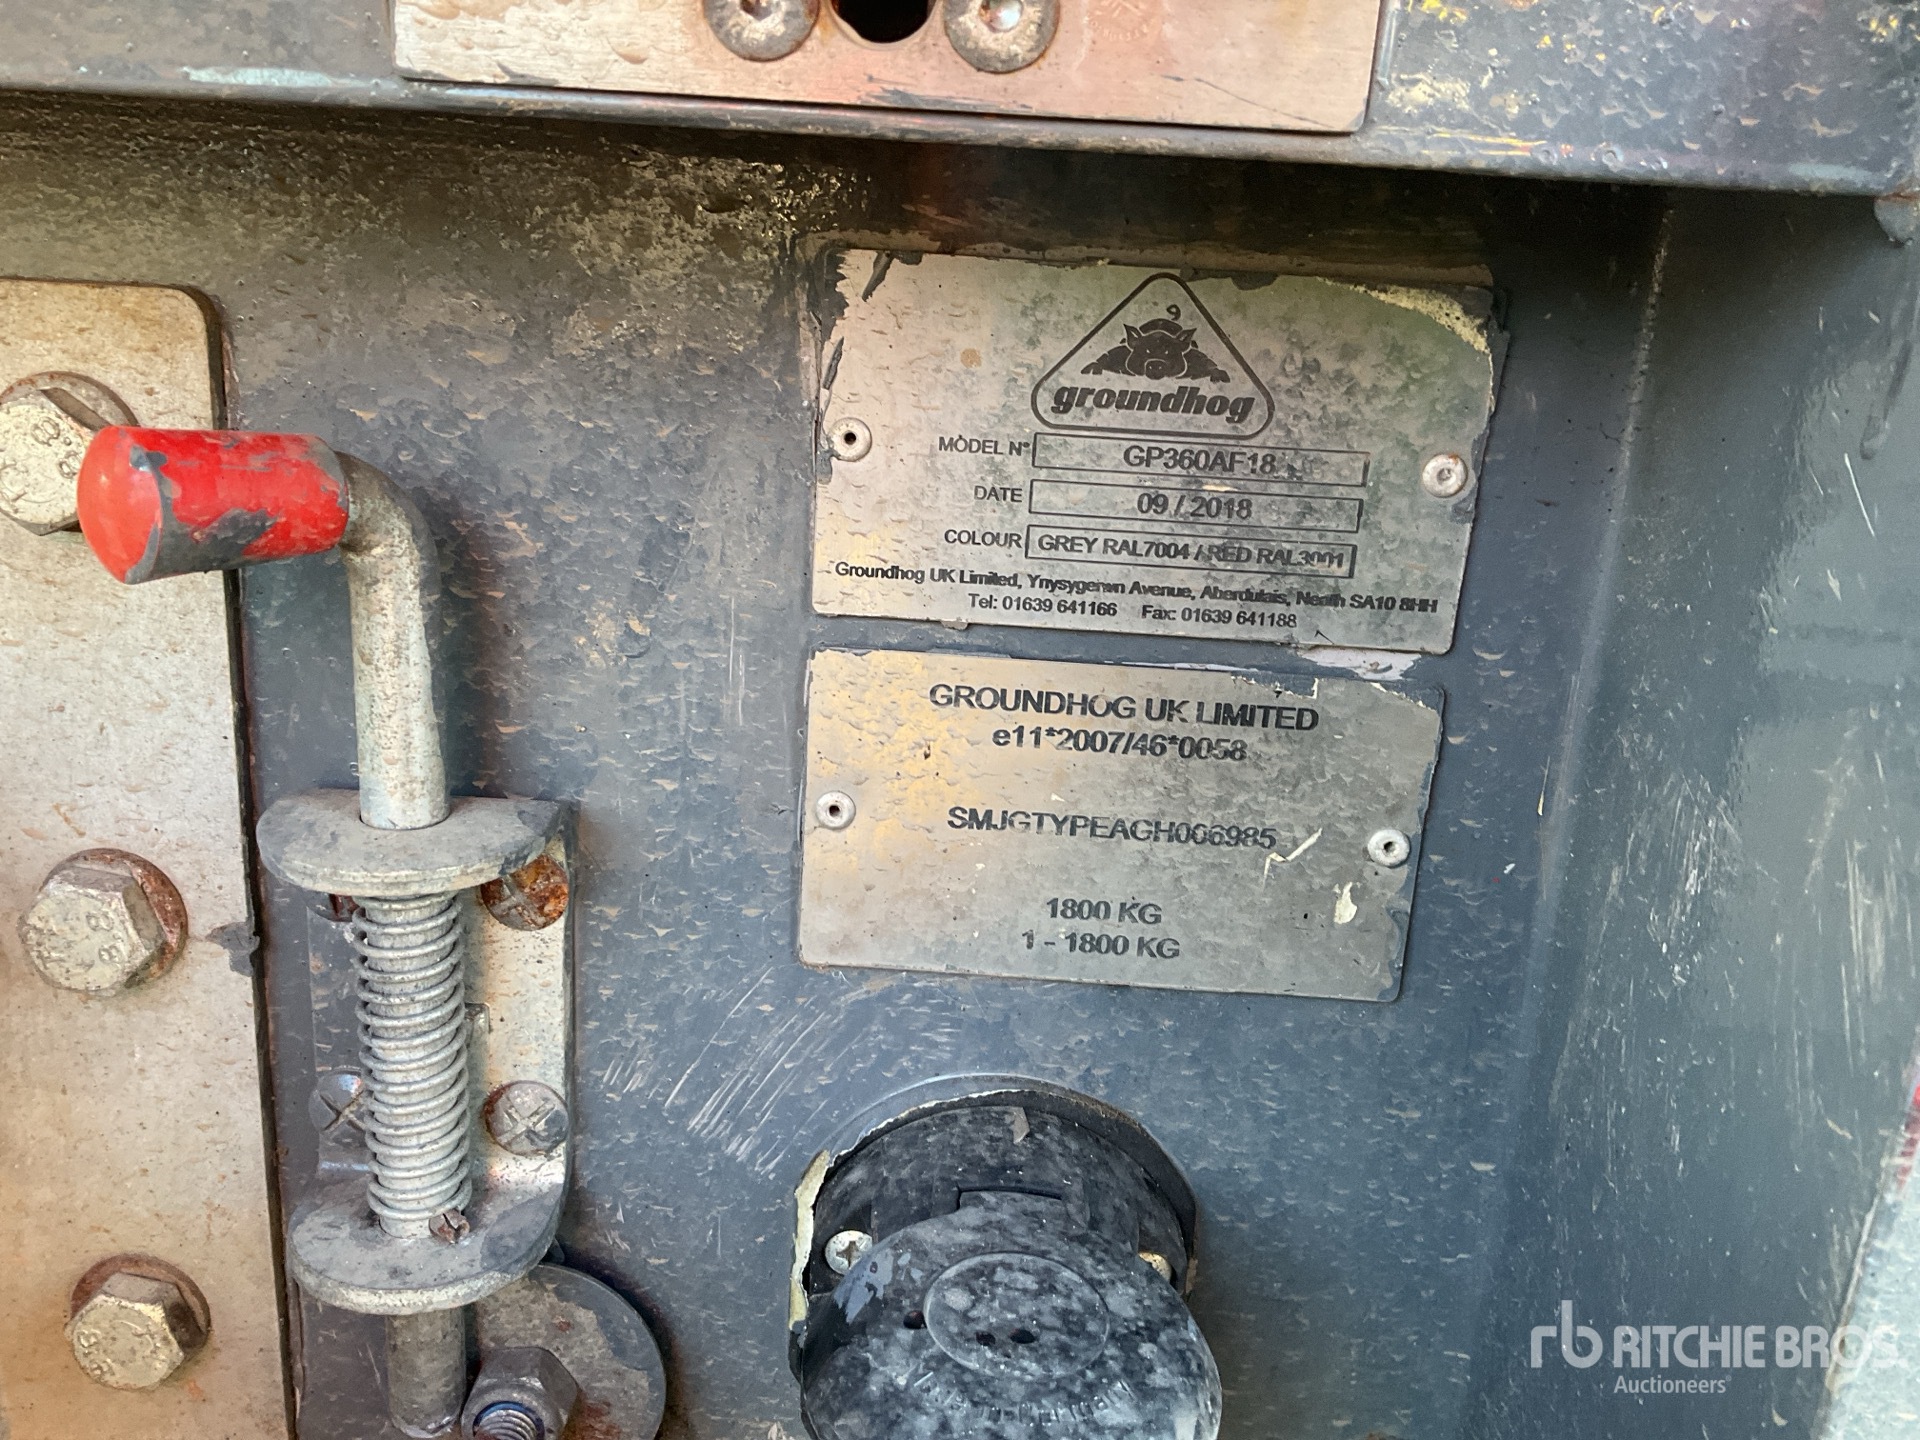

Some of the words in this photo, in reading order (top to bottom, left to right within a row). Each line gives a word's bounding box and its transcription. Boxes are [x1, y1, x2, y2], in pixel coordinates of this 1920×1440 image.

[1050, 385, 1256, 424] groundhog
[938, 436, 1004, 456] MODEL
[1123, 445, 1277, 475] GP360AF18
[974, 485, 1023, 503] DATE
[1137, 492, 1169, 515] 09
[1190, 496, 1253, 520] 2018
[944, 529, 1023, 549] COLOUR
[1037, 534, 1099, 554] GREY
[1102, 538, 1190, 560] RAL7004
[1207, 544, 1250, 563] RED
[835, 561, 925, 585] Groundhog
[929, 567, 955, 584] UK
[958, 569, 1023, 590] Limited,
[1128, 581, 1196, 601] Avenue,
[1349, 593, 1397, 611] SA10
[968, 593, 998, 610] Tel:
[1001, 594, 1053, 613] 01639
[1056, 598, 1118, 617] 641166
[1141, 603, 1177, 620] Fax:
[1180, 606, 1232, 625] 01639
[1235, 610, 1298, 628] 641188
[929, 683, 1136, 720] GROUNDHOG
[1145, 697, 1188, 724] UK
[1196, 700, 1319, 732] LIMITED
[1046, 897, 1111, 921] 1800
[1117, 901, 1163, 925] KG
[1021, 929, 1036, 950] 1
[1064, 932, 1130, 958] 1800
[1136, 936, 1181, 960] KG
